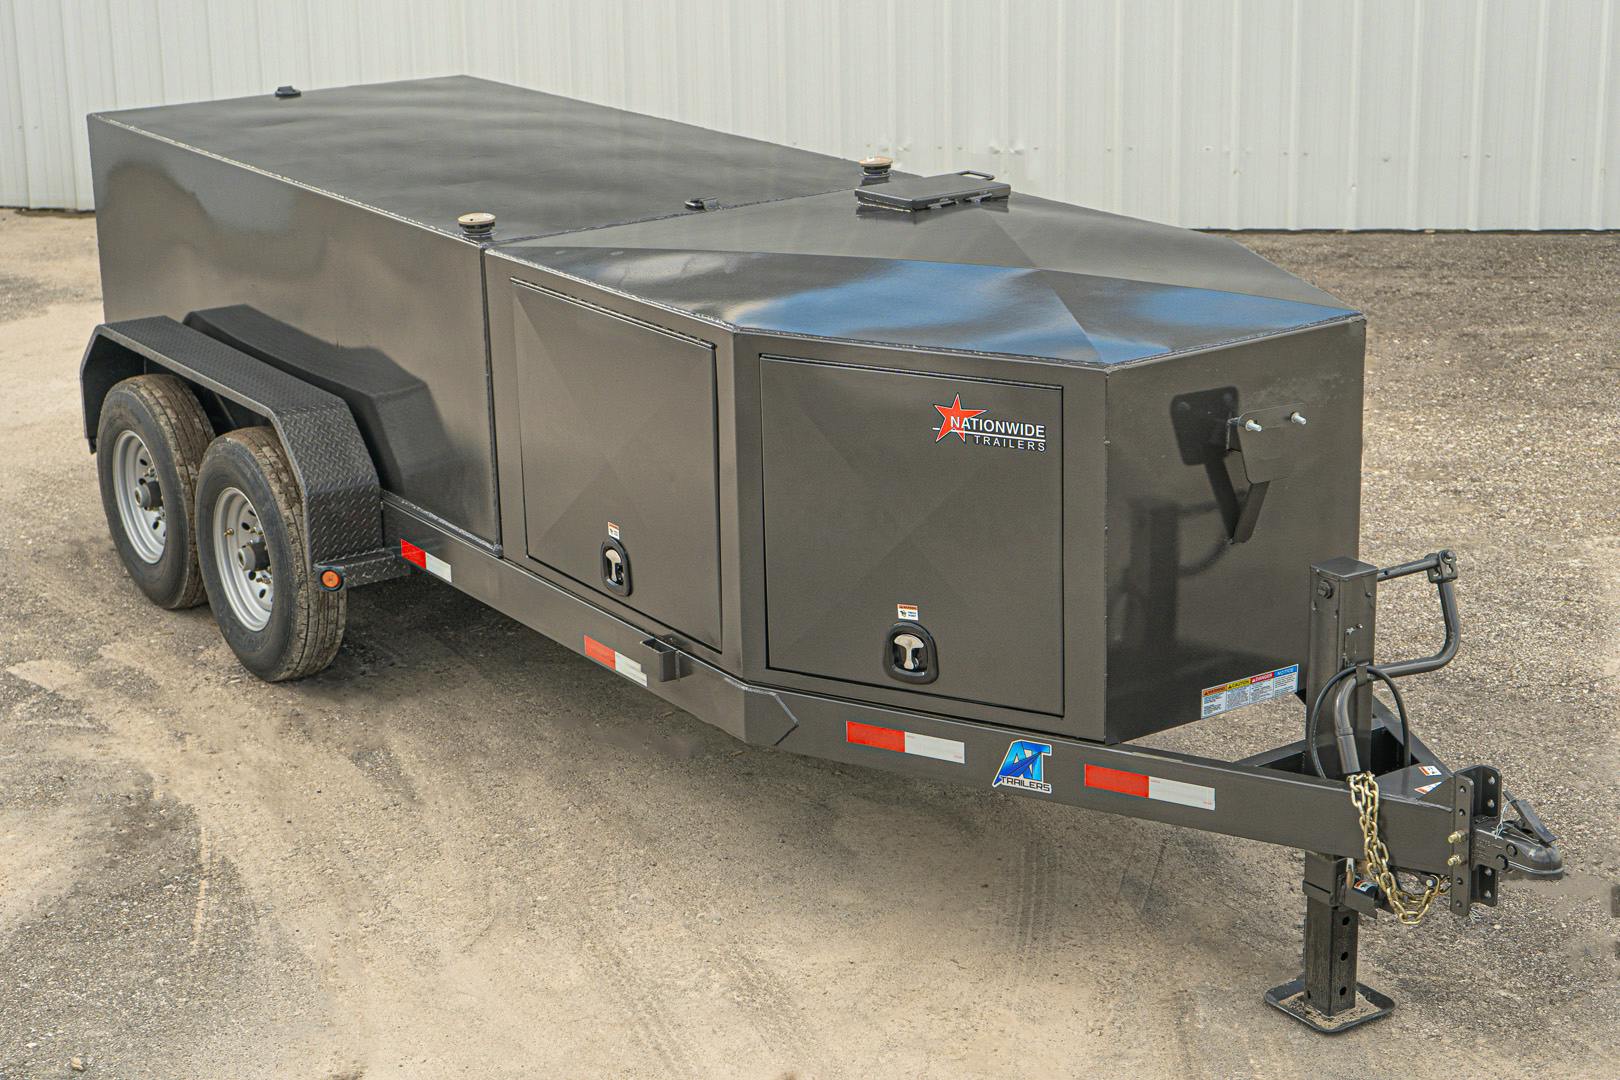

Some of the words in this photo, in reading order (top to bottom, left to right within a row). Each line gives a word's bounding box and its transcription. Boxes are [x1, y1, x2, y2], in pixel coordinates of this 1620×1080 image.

[950, 416, 1045, 437] NATIONWIDE
[974, 435, 1045, 451] TRAILERS
[1001, 776, 1051, 791] TRAILERS
